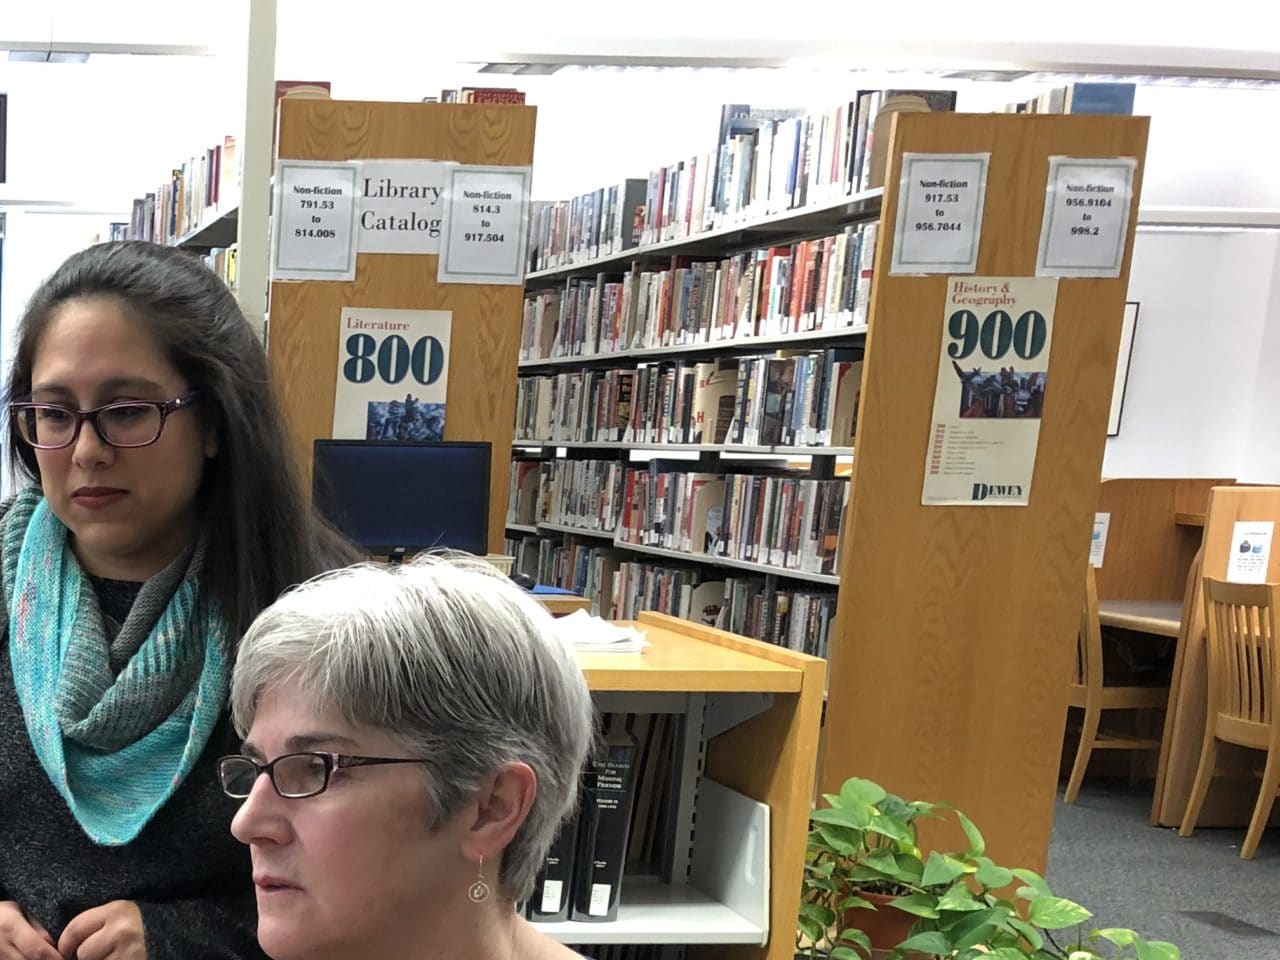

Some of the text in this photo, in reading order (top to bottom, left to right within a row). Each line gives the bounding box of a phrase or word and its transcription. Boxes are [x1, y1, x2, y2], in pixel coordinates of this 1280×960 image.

[919, 180, 968, 189] Non-fiction
[1066, 184, 1115, 193] Non-fiction
[293, 185, 342, 196] Non-fiction
[363, 178, 444, 205] Library
[462, 190, 512, 200] Non-fiction
[924, 194, 959, 203] 917.53
[300, 200, 334, 210] 791.53
[472, 205, 501, 214] 814.3
[935, 209, 945, 217] to
[1082, 213, 1092, 221] to
[311, 215, 321, 224] to
[361, 210, 442, 237] Catalog
[481, 220, 490, 228] to
[295, 229, 335, 239] 814.008
[464, 233, 504, 243] 917.504
[953, 282, 1011, 295] History &
[952, 294, 1017, 307] Geography
[347, 317, 410, 331] Literature
[947, 309, 1047, 360] 900
[343, 333, 444, 385] 800
[971, 483, 1024, 501] DEWEY
